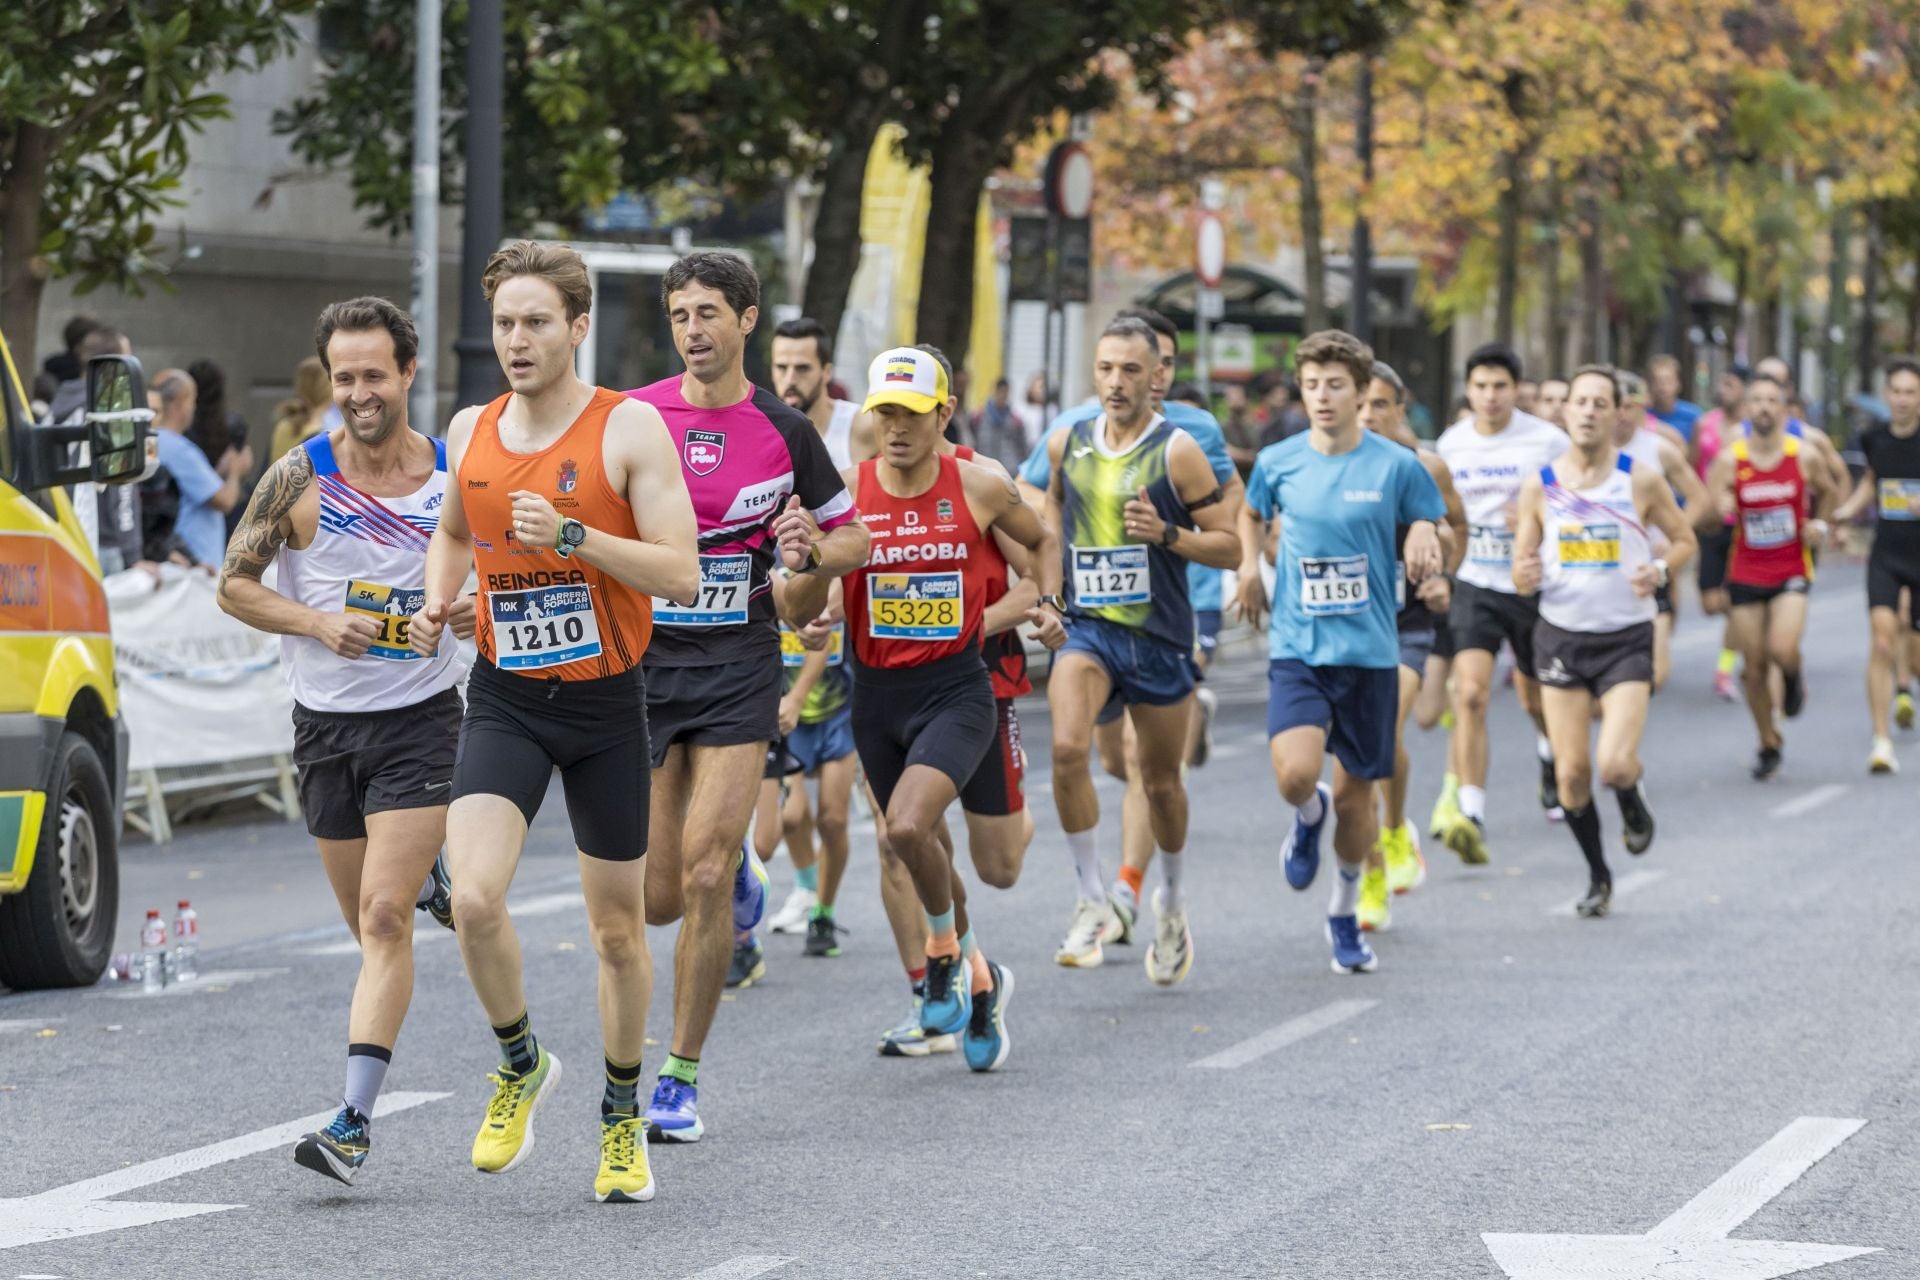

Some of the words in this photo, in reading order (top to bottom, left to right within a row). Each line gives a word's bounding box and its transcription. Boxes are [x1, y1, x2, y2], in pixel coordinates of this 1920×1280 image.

[888, 356, 917, 364] ECUADOR
[695, 433, 716, 441] TEAM
[467, 480, 489, 488] Protex
[743, 490, 775, 509] TEAM
[896, 525, 928, 537] Beco
[863, 543, 968, 566] ÁRCOBA
[710, 561, 748, 569] CARRERA
[708, 567, 747, 575] POPULAR
[487, 570, 585, 591] REINOSA
[1085, 573, 1138, 592] 1127
[358, 590, 376, 601] 5K
[543, 591, 588, 602] CARRERA
[1311, 582, 1362, 600] 1150
[407, 594, 425, 603] CAR
[543, 597, 588, 610] POPULAR
[499, 601, 517, 612] 10K
[880, 601, 954, 625] 5328
[508, 616, 584, 650] 1210
